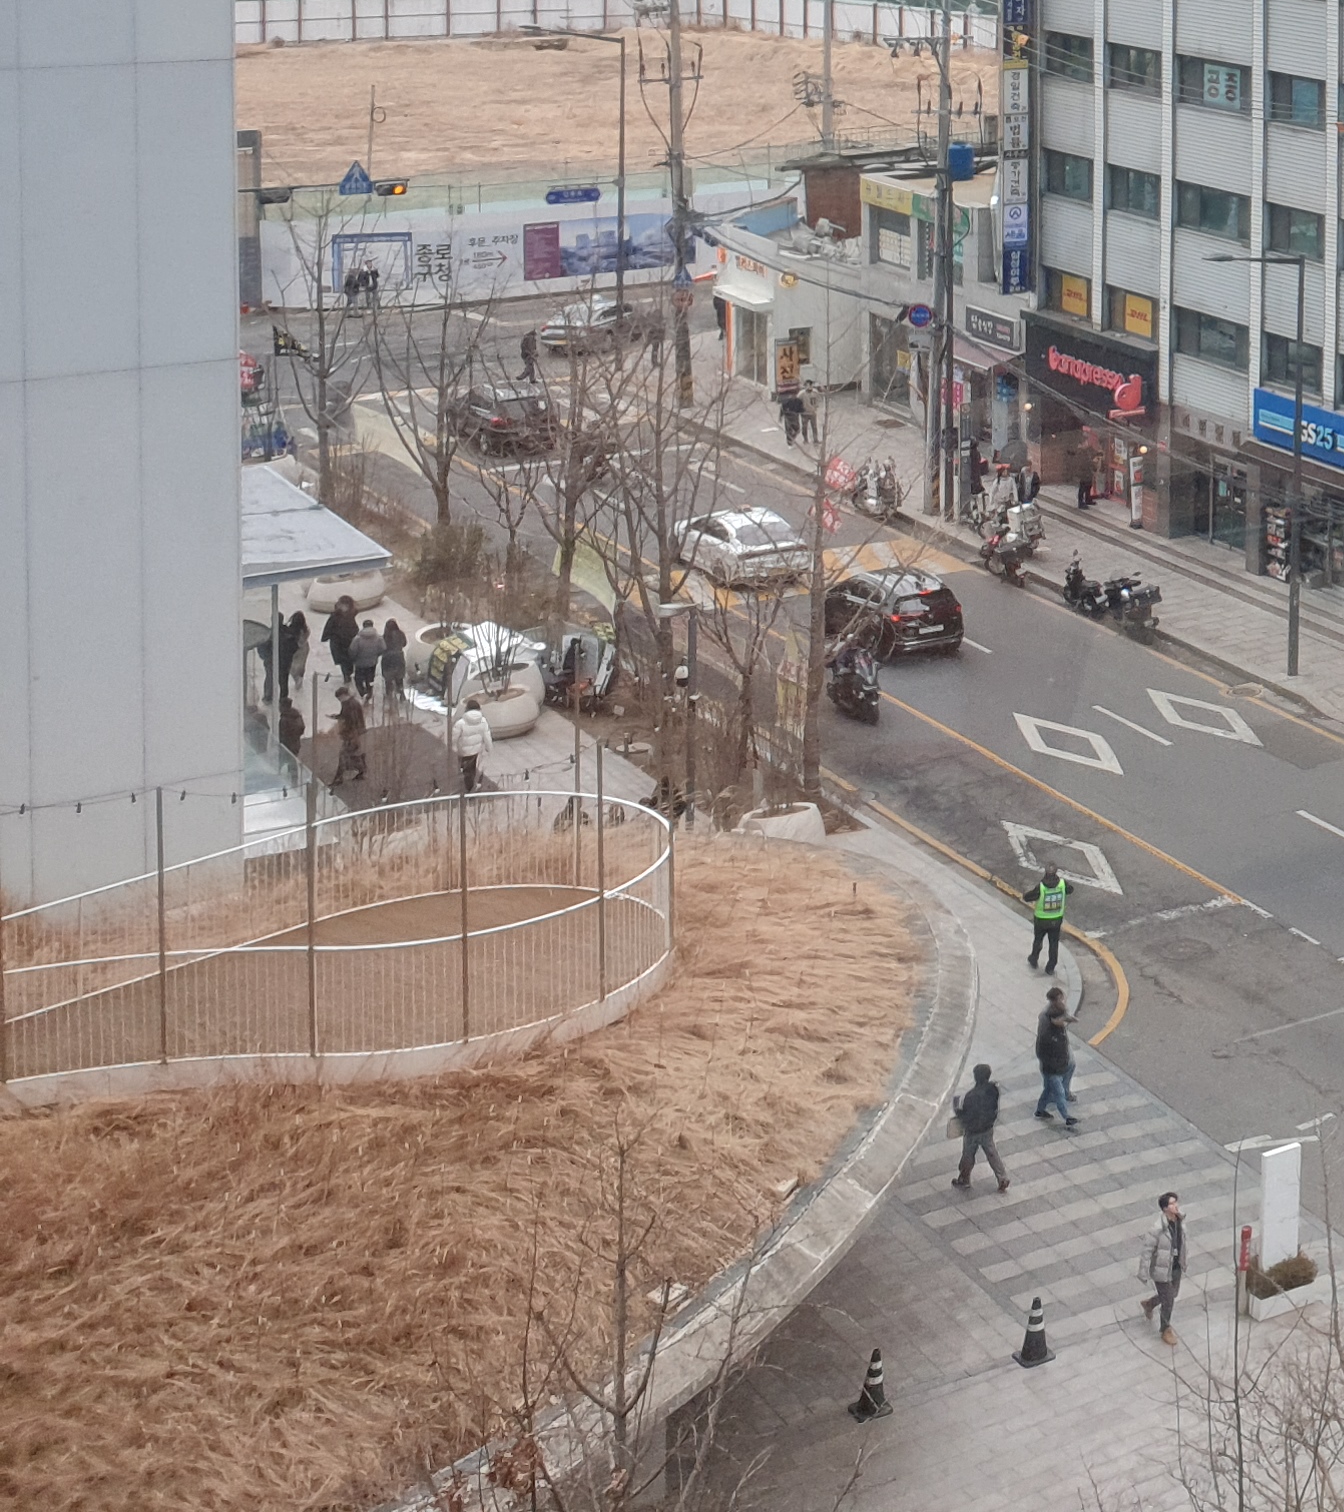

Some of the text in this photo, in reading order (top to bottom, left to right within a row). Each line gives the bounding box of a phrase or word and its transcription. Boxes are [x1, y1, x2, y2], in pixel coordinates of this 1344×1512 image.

[1206, 69, 1240, 103] 공증
[415, 244, 453, 264] 종로
[414, 262, 453, 282] 구청
[1066, 288, 1086, 302] DHL
[1129, 309, 1149, 323] DHL
[780, 346, 796, 380] 사진
